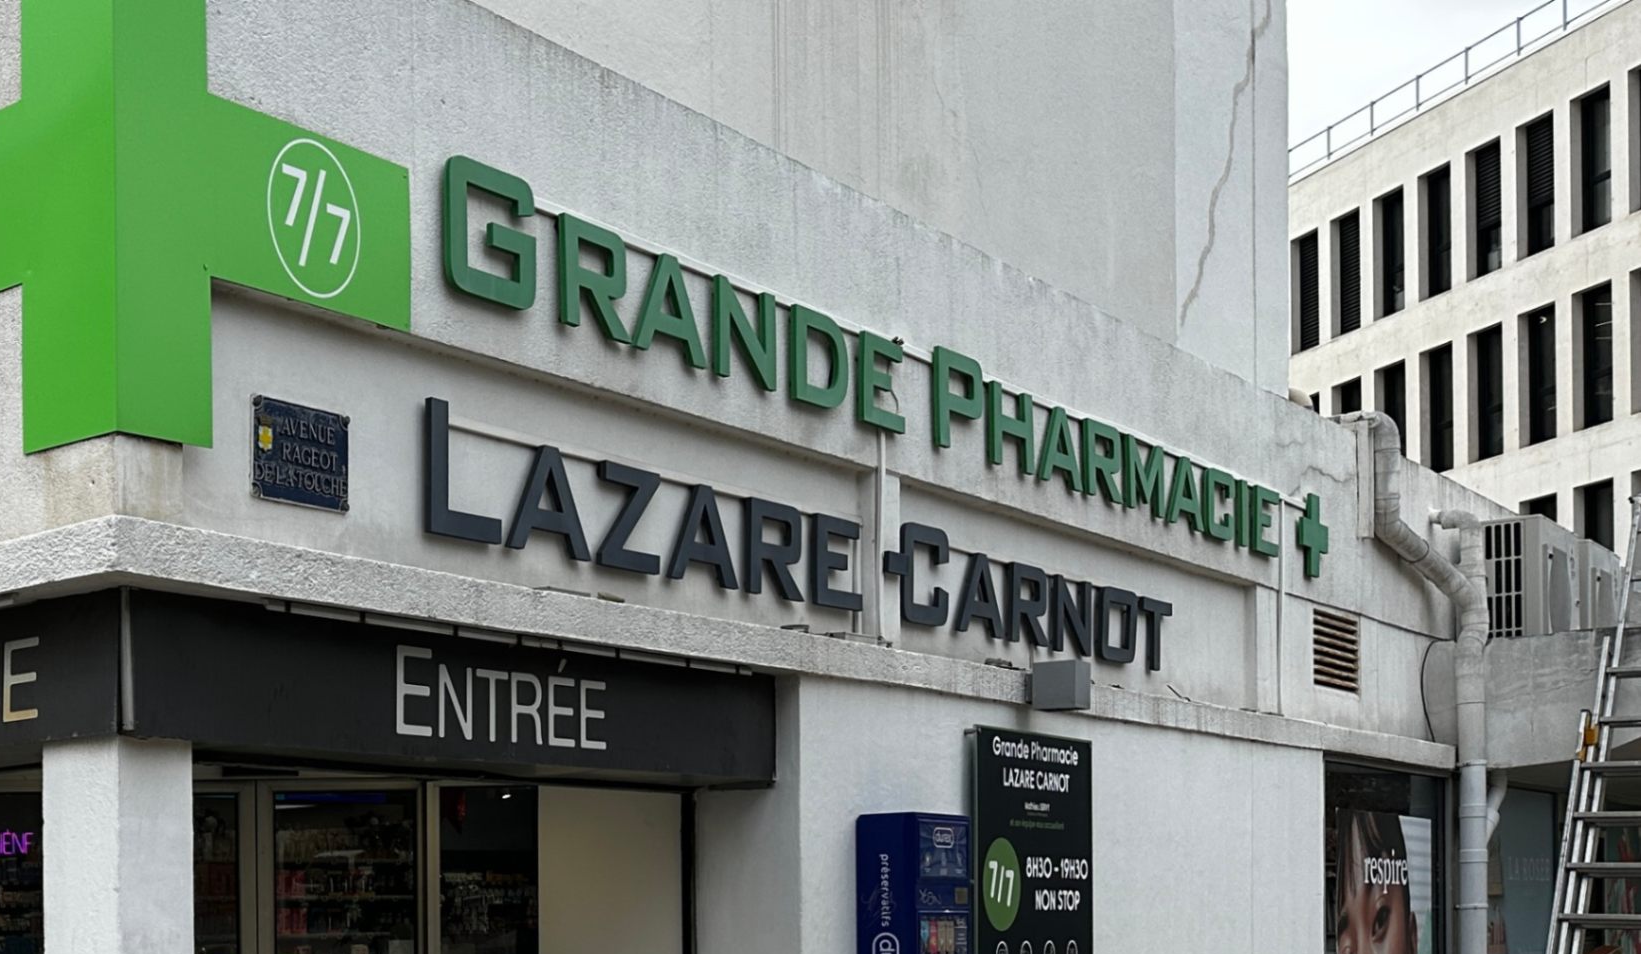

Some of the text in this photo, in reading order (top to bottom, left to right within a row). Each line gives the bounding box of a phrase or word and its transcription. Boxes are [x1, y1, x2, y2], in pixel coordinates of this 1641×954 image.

[281, 162, 351, 268] 7/7
[442, 153, 1281, 558] GRANDE PHARMACIE
[279, 417, 336, 445] AVENUE
[282, 442, 338, 471] RAGEOT
[254, 462, 274, 483] DE
[395, 645, 609, 751] ENTRÉE
[992, 736, 1078, 766] Grande Pharmacie
[1003, 767, 1070, 793] LAZARE CARNOT
[989, 860, 1014, 907] 7/7
[1025, 857, 1052, 879] 8H30
[1060, 858, 1088, 880] 19H30
[1364, 849, 1408, 894] respire
[879, 853, 892, 928] préservatifs
[1035, 890, 1081, 911] NON STOP
